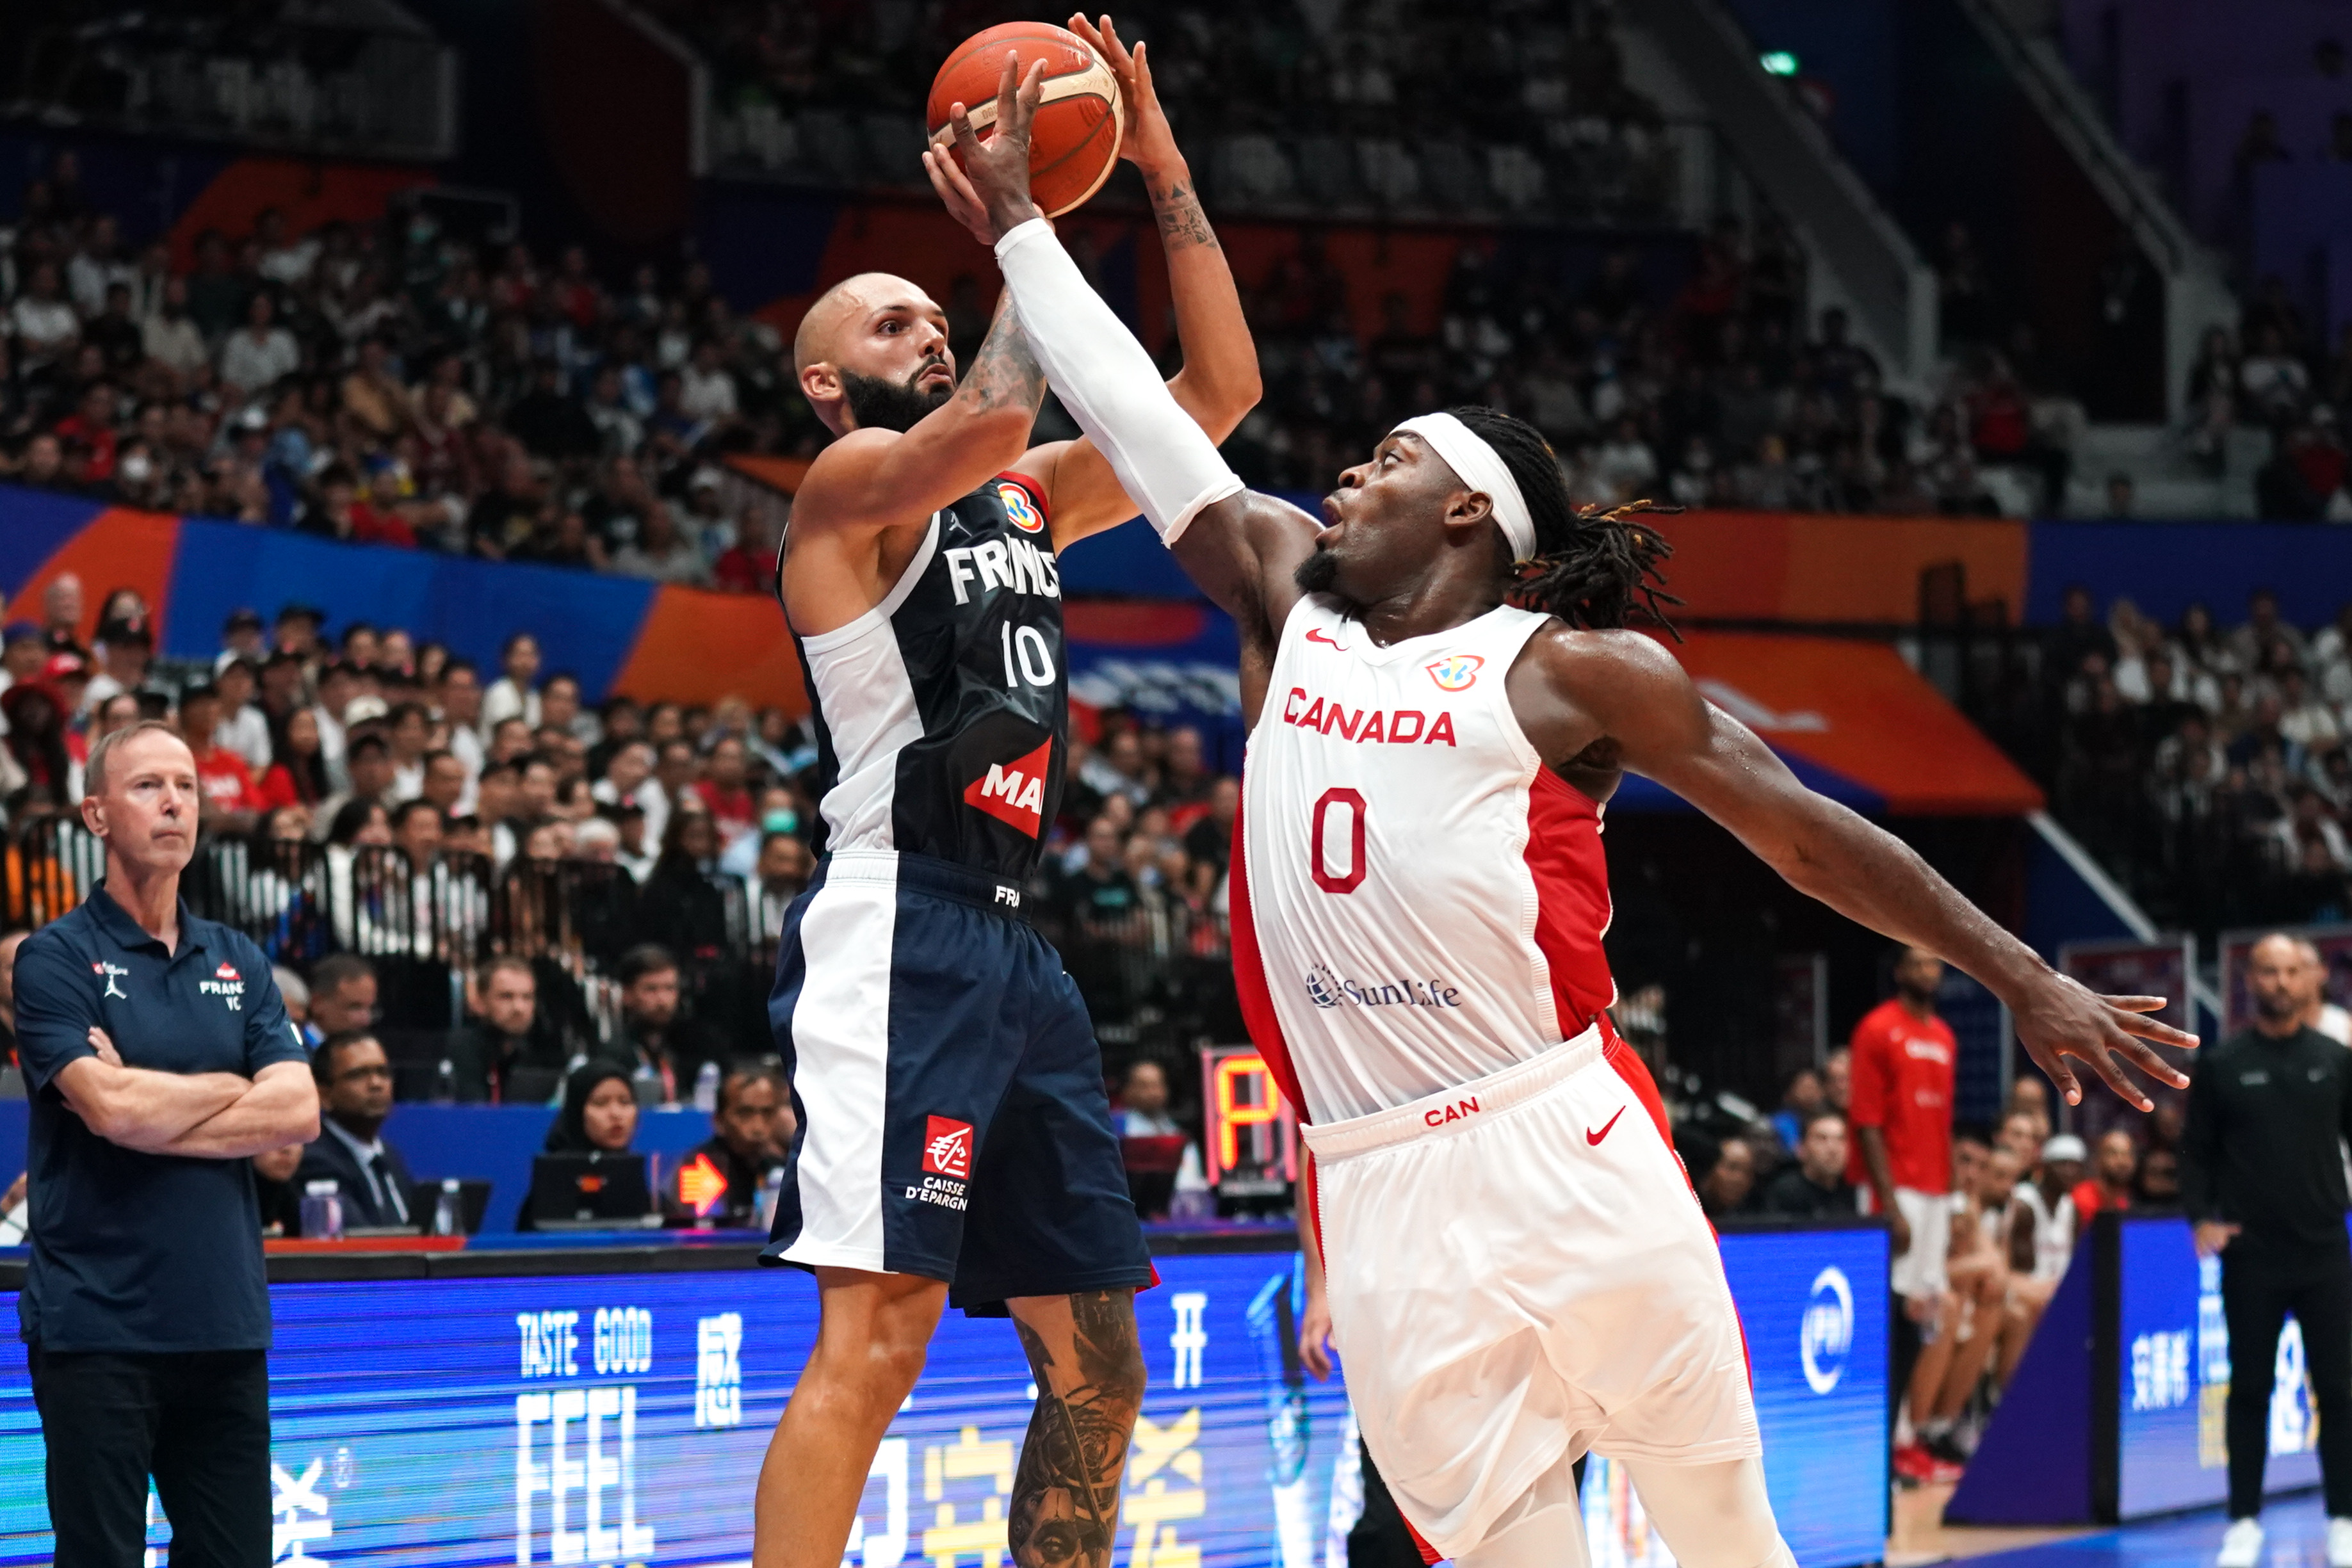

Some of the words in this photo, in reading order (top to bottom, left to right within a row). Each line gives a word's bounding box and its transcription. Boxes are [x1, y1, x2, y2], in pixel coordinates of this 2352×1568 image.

[1001, 620, 1056, 687] 10
[1284, 687, 1457, 747] CANADA
[980, 763, 1046, 815] MA
[1311, 788, 1367, 894] 0
[1425, 1096, 1480, 1127] CAN
[905, 1186, 968, 1211] D'EPARGN
[923, 1176, 966, 1196] CAISSE
[517, 1311, 579, 1378] TASTE
[594, 1307, 652, 1374] GOOD
[515, 1386, 654, 1565] FEEL
